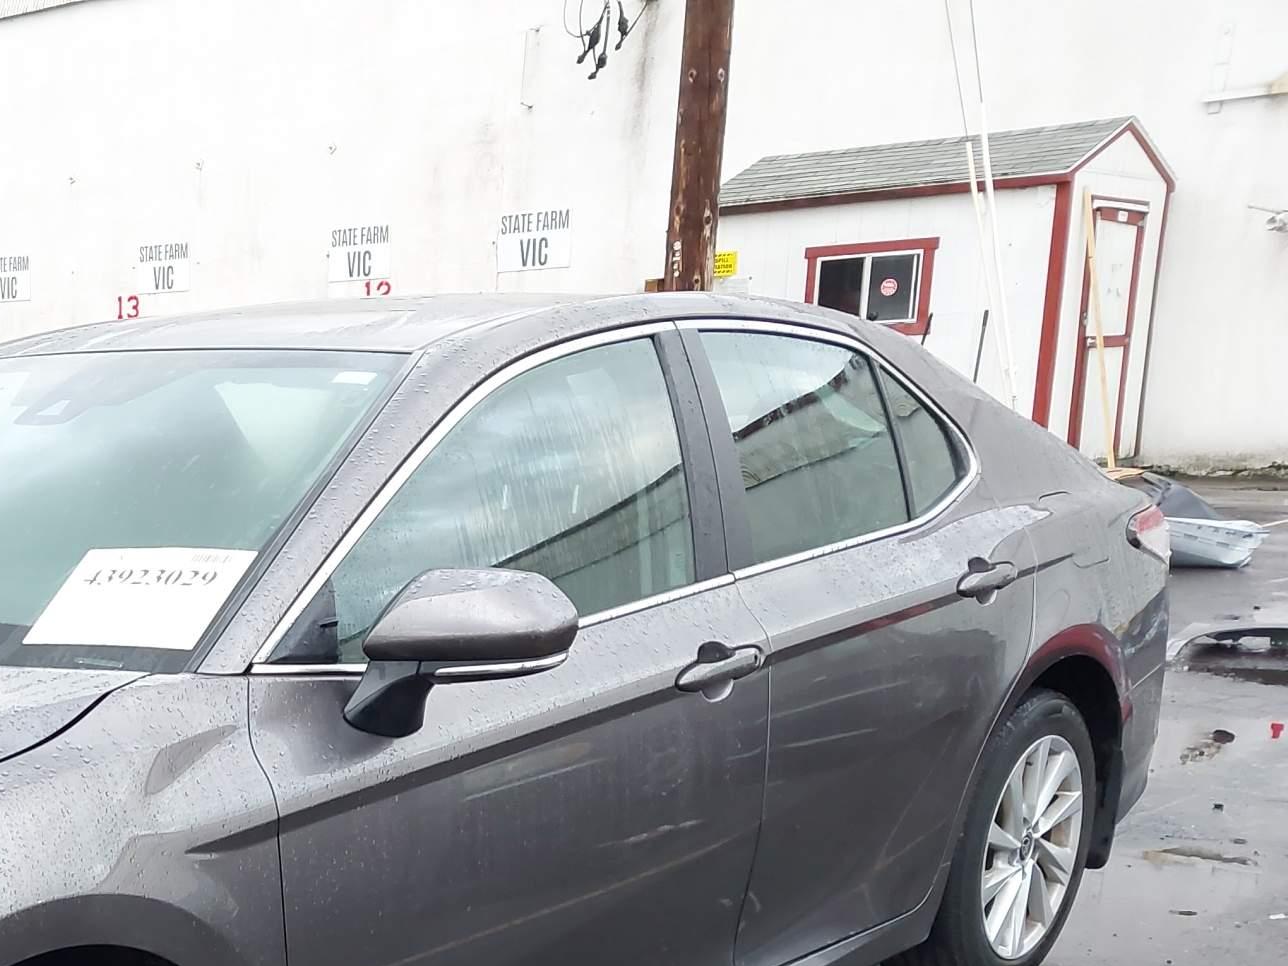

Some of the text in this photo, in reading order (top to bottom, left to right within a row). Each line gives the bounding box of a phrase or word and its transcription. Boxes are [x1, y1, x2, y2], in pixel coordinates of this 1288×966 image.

[501, 208, 570, 235] STATE FARM
[332, 225, 389, 248] STATE FARM
[139, 241, 189, 263] STATE FARM
[347, 250, 372, 277] VIC
[520, 236, 548, 267] VIC
[9, 256, 29, 272] FARM
[0, 277, 18, 299] VIC
[153, 265, 174, 290] VIC
[117, 295, 140, 320] 13
[84, 569, 218, 586] 43923029
